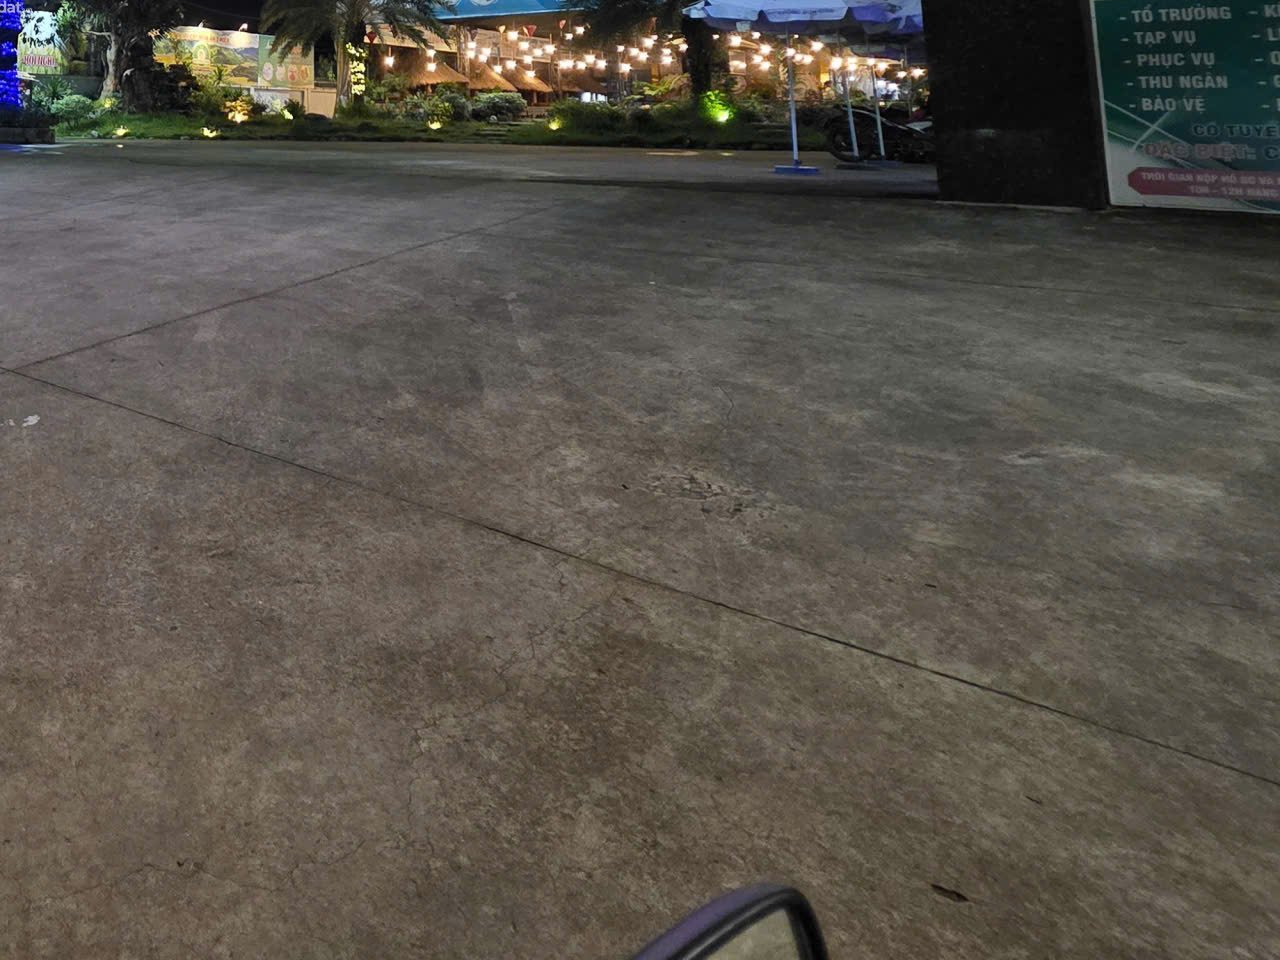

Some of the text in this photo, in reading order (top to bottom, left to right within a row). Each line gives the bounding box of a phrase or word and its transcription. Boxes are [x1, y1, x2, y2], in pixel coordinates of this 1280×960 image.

[1134, 32, 1166, 48] TẠP
[1172, 30, 1196, 46] VỤ
[1136, 53, 1185, 69] PHỤC
[1191, 52, 1215, 69] VỤ
[1138, 75, 1173, 88] THU
[1183, 95, 1206, 114] VỆ
